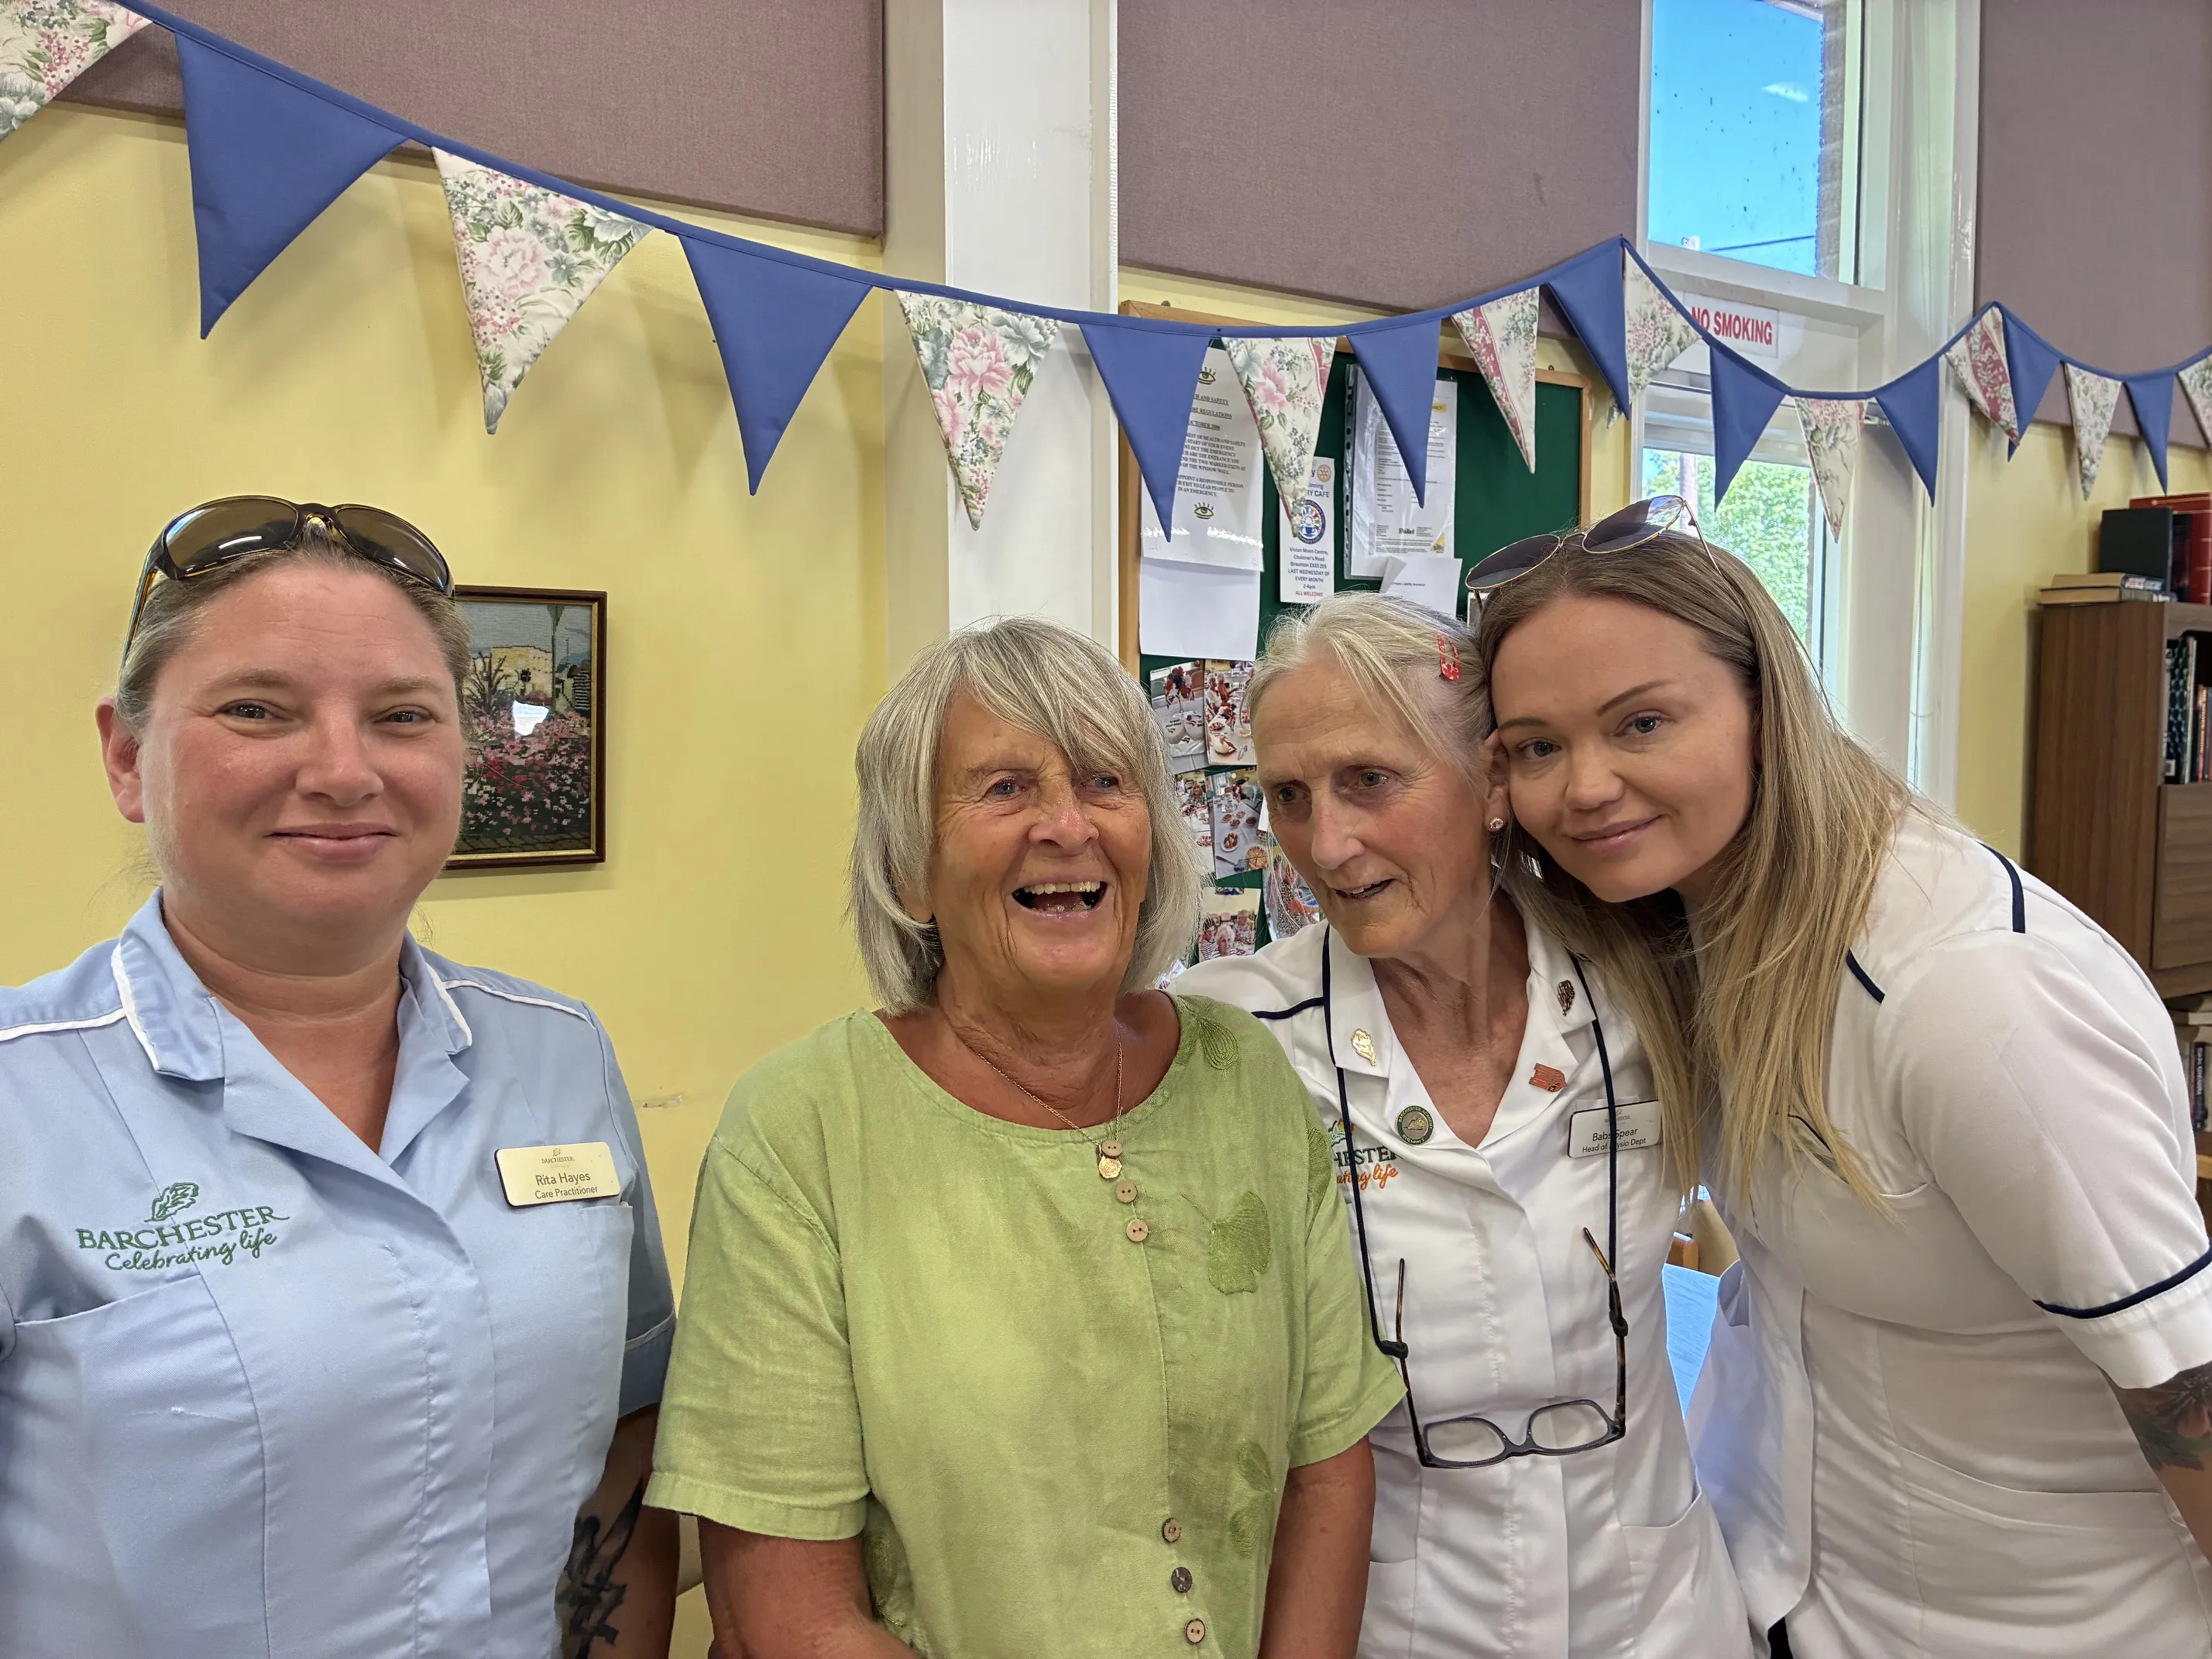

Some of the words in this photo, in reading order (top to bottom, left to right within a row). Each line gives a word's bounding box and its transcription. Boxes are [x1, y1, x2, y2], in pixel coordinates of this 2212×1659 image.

[1692, 307, 1710, 331] NO
[1713, 311, 1773, 345] SMOKING
[1592, 1132, 1611, 1142] Babs
[1616, 1128, 1638, 1140] Spear
[1610, 1140, 1630, 1150] ysio
[1630, 1138, 1647, 1146] Dept
[535, 1174, 557, 1186] Rita
[558, 1172, 591, 1186] Hayes
[1372, 1163, 1399, 1189] life
[534, 1190, 554, 1199] Care
[555, 1185, 598, 1197] Practitioner
[75, 1206, 290, 1250] BARCHESTER
[105, 1241, 236, 1270] Celebrating
[239, 1227, 277, 1259] life
